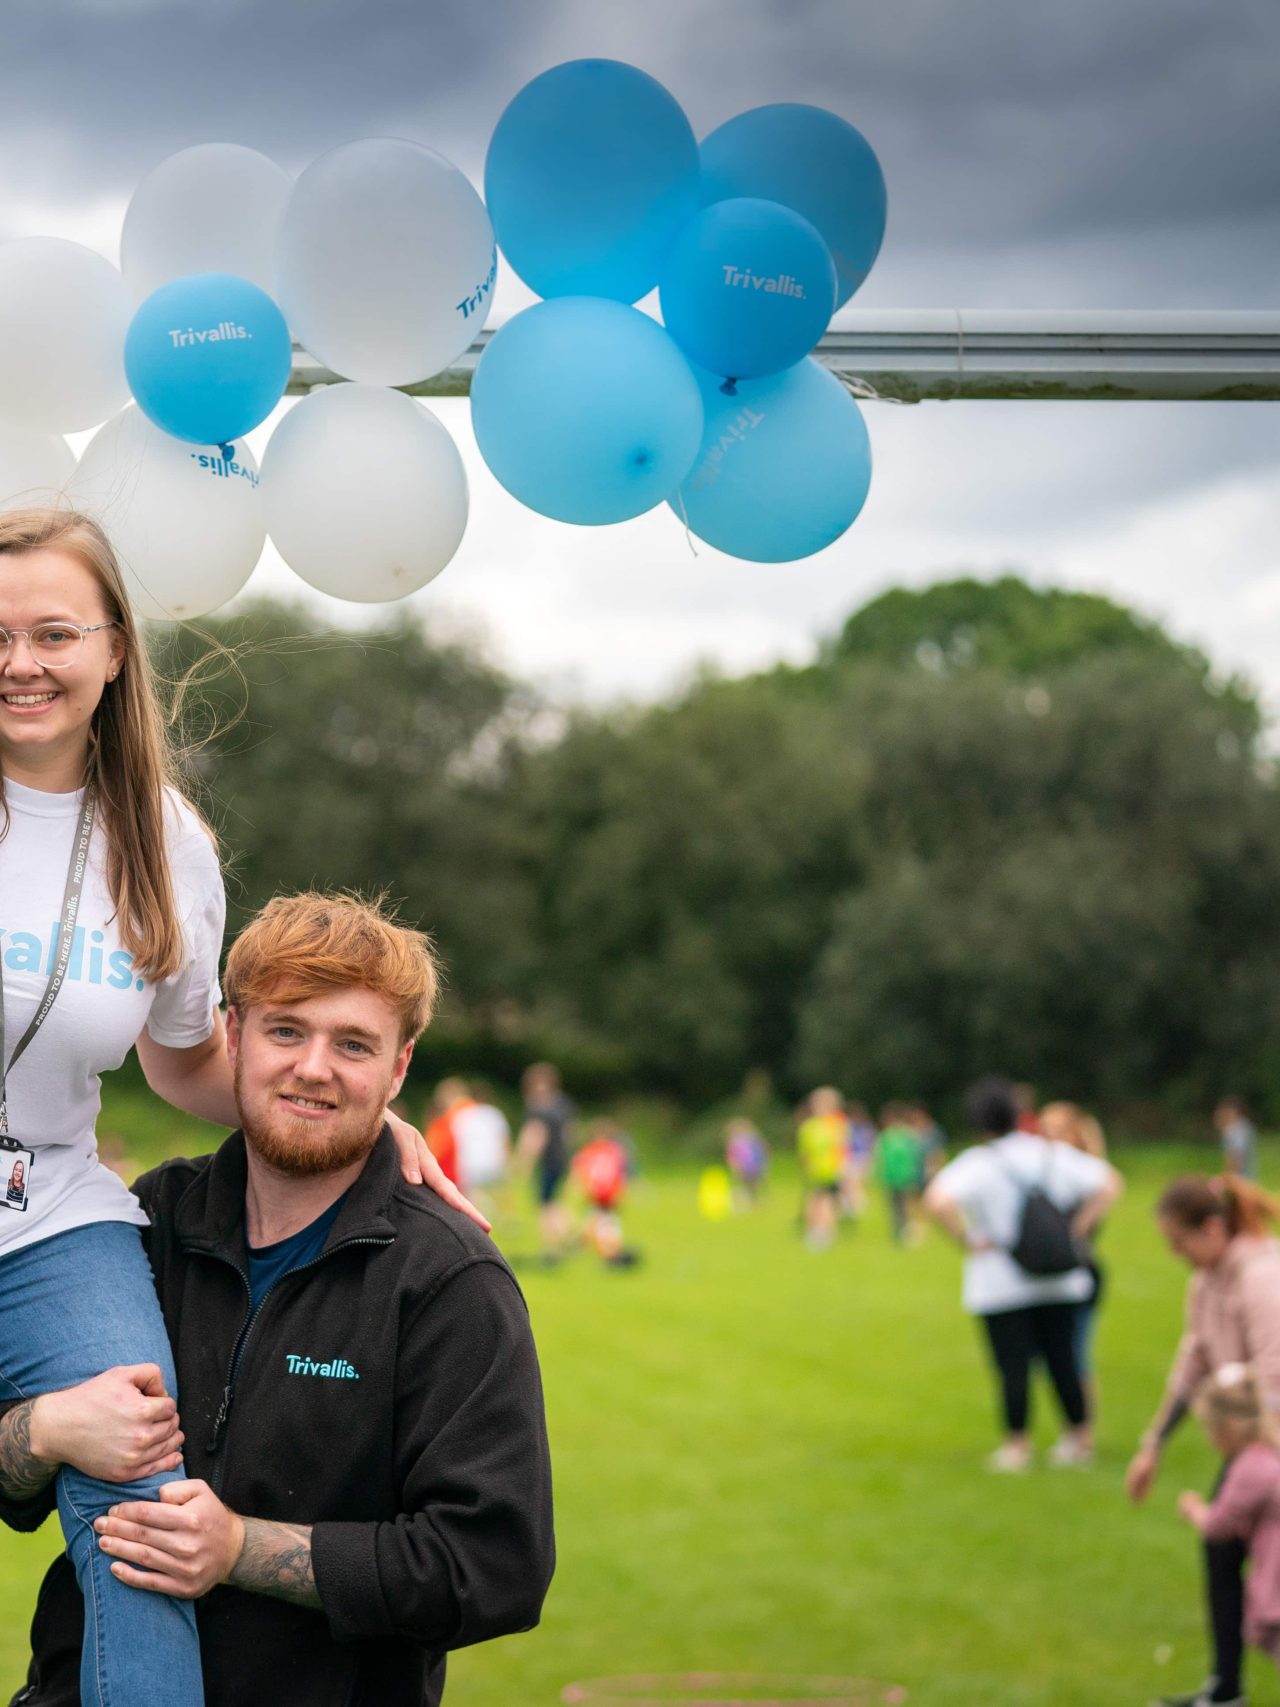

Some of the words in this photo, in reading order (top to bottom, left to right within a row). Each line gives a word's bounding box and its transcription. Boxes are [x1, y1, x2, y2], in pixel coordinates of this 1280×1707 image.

[722, 264, 807, 300] Trivallis.
[168, 321, 252, 348] Trivallis.
[82, 823, 91, 836] BE
[79, 837, 88, 851] TO
[73, 851, 85, 884] PROUD
[63, 894, 79, 933] Trivallis.
[61, 936, 72, 962] HERE.
[57, 963, 66, 976] BE
[51, 977, 61, 993] TO
[36, 993, 55, 1026] PROUD
[286, 1354, 360, 1379] Trivallis.
